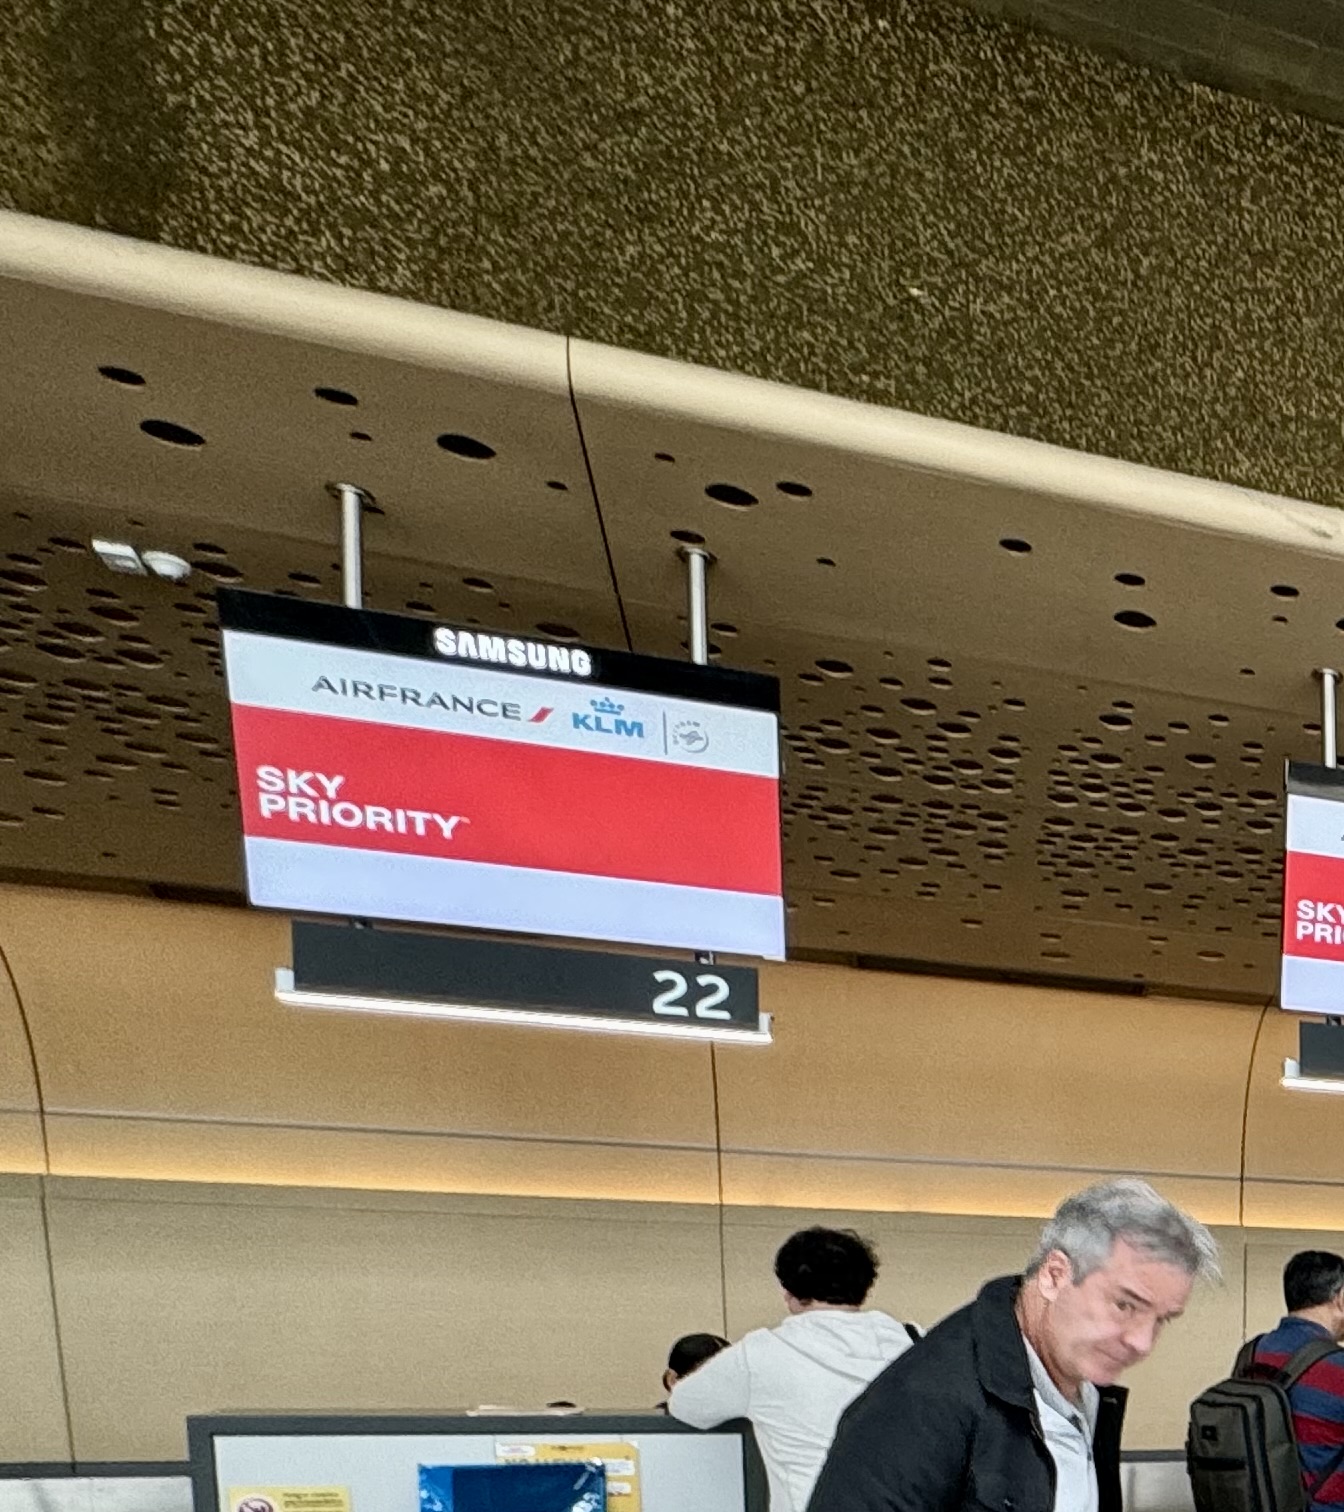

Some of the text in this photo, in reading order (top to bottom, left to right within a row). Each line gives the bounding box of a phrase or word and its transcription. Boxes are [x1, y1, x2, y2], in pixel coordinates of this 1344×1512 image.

[433, 627, 591, 675] SAMSUNG
[311, 675, 521, 722] AIRFRANCE
[571, 713, 645, 740] KLM
[255, 764, 345, 799] SKY
[259, 794, 463, 840] PRIORITY
[650, 969, 734, 1021] 22
